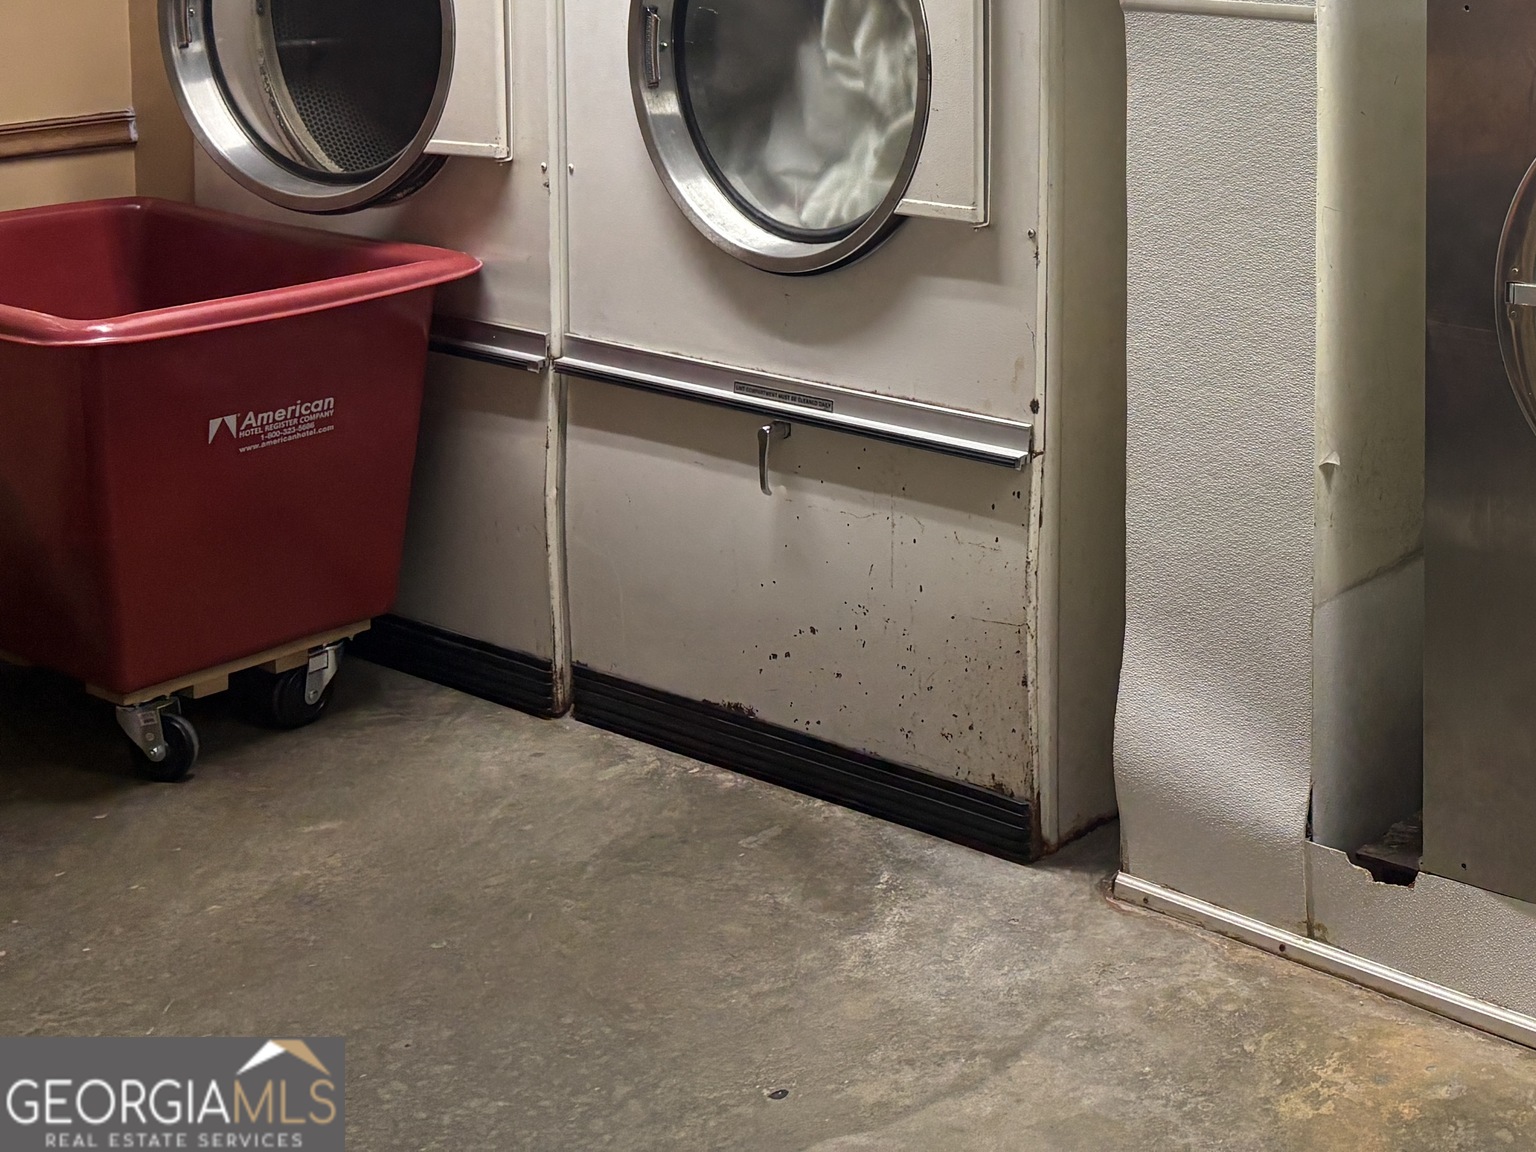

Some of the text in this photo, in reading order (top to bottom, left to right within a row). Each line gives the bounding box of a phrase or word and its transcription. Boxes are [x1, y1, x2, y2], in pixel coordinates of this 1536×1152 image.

[240, 397, 334, 430] American
[798, 396, 818, 406] CLEANED
[239, 409, 334, 438] HOTEL REGISTER COMPANY
[239, 425, 334, 453] www.americanhotel.com
